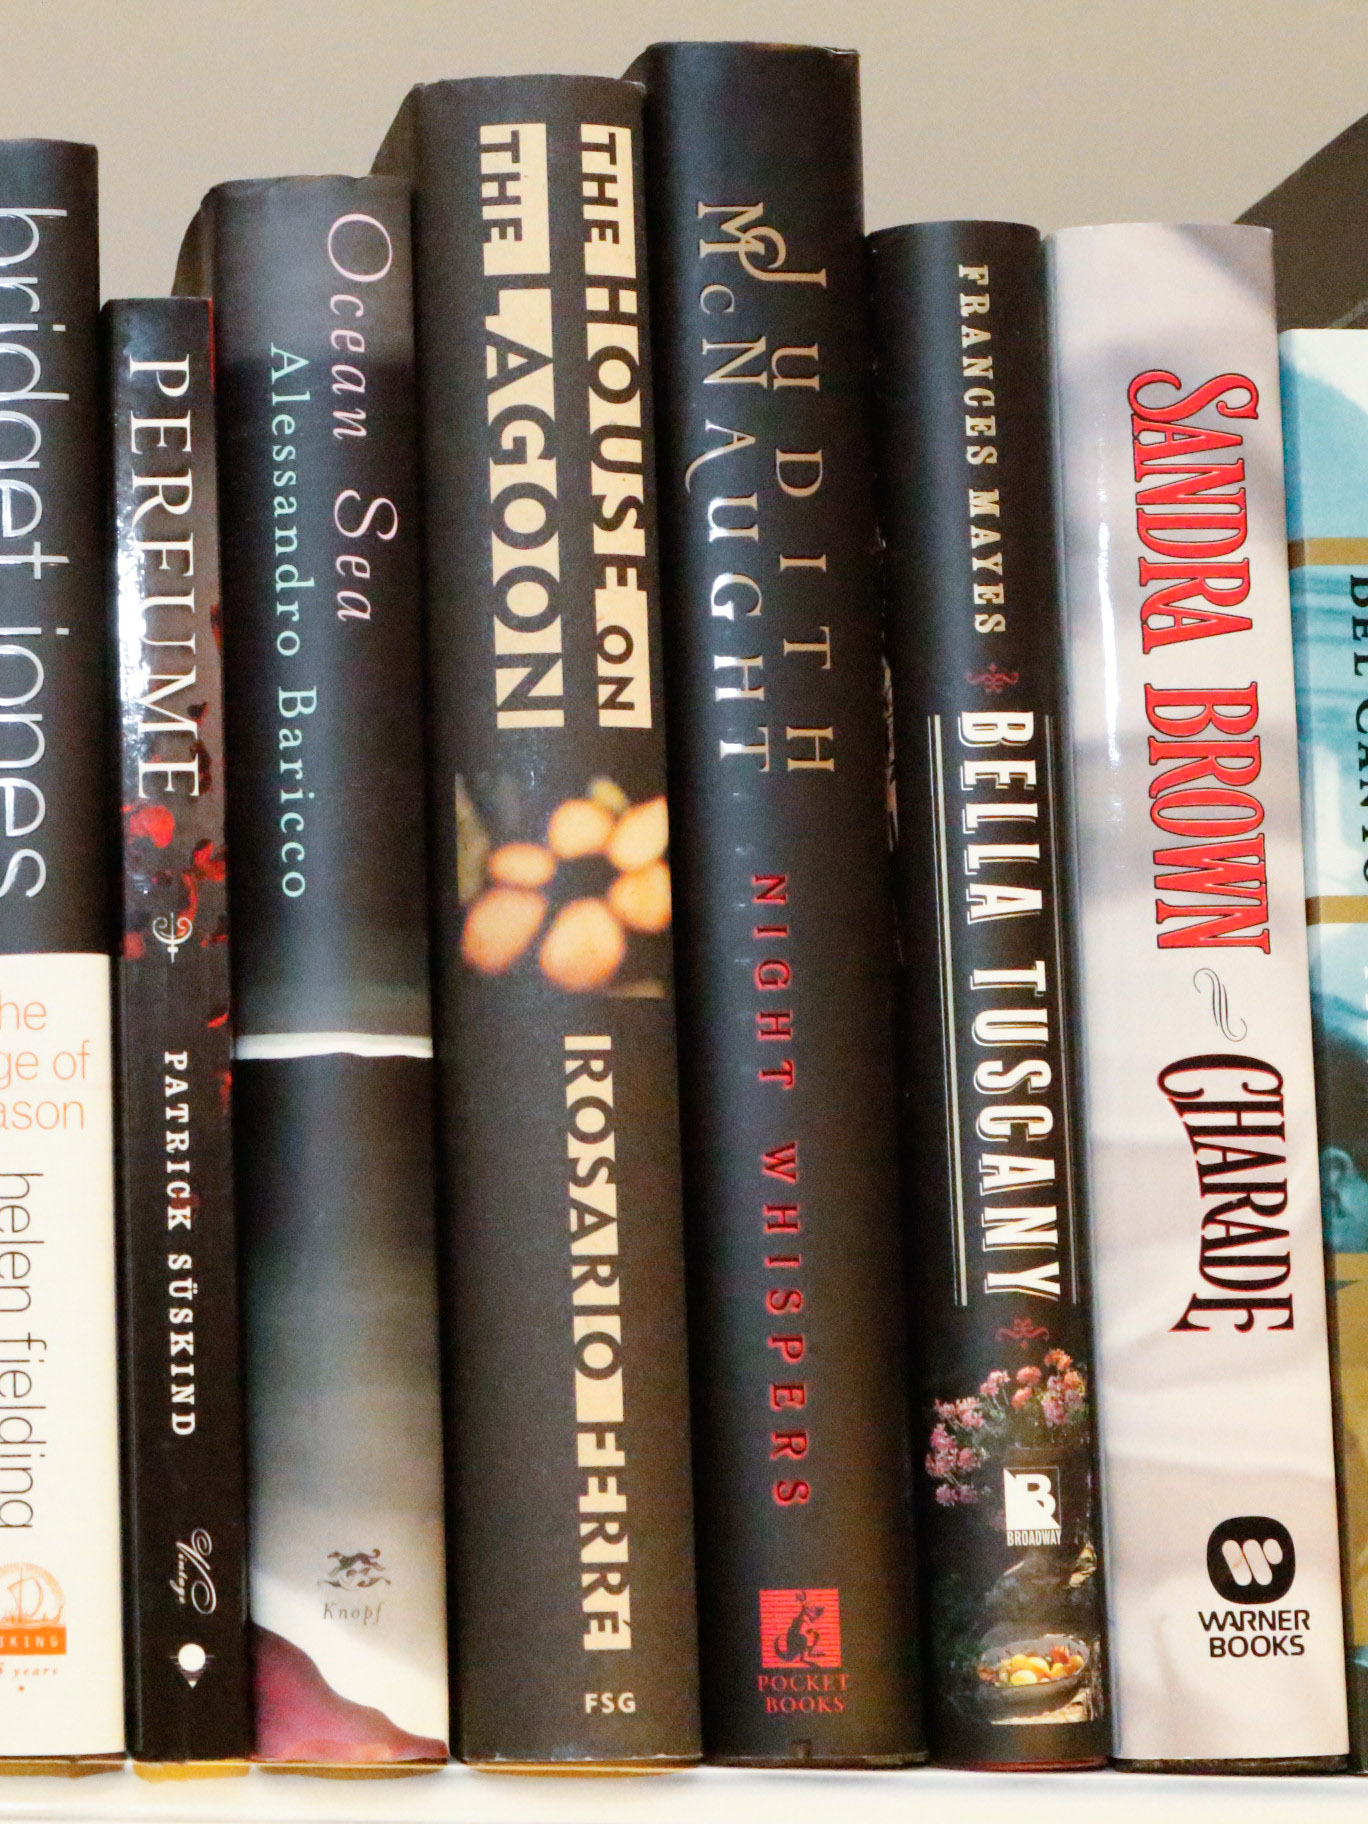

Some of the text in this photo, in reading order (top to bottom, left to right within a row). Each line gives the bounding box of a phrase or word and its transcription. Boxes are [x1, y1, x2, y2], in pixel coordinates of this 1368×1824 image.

[580, 126, 630, 262] THE
[327, 212, 399, 622] Ocean Sea
[480, 124, 564, 728] THE LAGOON
[584, 280, 647, 597] HOUSE
[958, 263, 1006, 634] FRANCES MAYES
[128, 353, 201, 800] PERFUME
[270, 343, 318, 899] Alessandro Baricco
[1127, 368, 1272, 956] SANDRA BROWN
[52, 1040, 92, 1081] of
[957, 710, 1062, 1302] BELLA TUSCANY
[164, 1050, 199, 1437] PATRICK SÜSKIND
[564, 1037, 624, 1386] ROSARIO
[753, 873, 811, 1507] NIGHT WHISPERS
[1157, 1053, 1295, 1333] CHARADE
[322, 1602, 385, 1626] Knopf
[758, 1672, 851, 1693] POCKET
[1006, 1530, 1062, 1547] BROADWAY
[1199, 1609, 1311, 1633] WARNER
[1208, 1635, 1305, 1659] BOOKS
[584, 1692, 637, 1714] FSG
[765, 1695, 845, 1715] BOOKS
